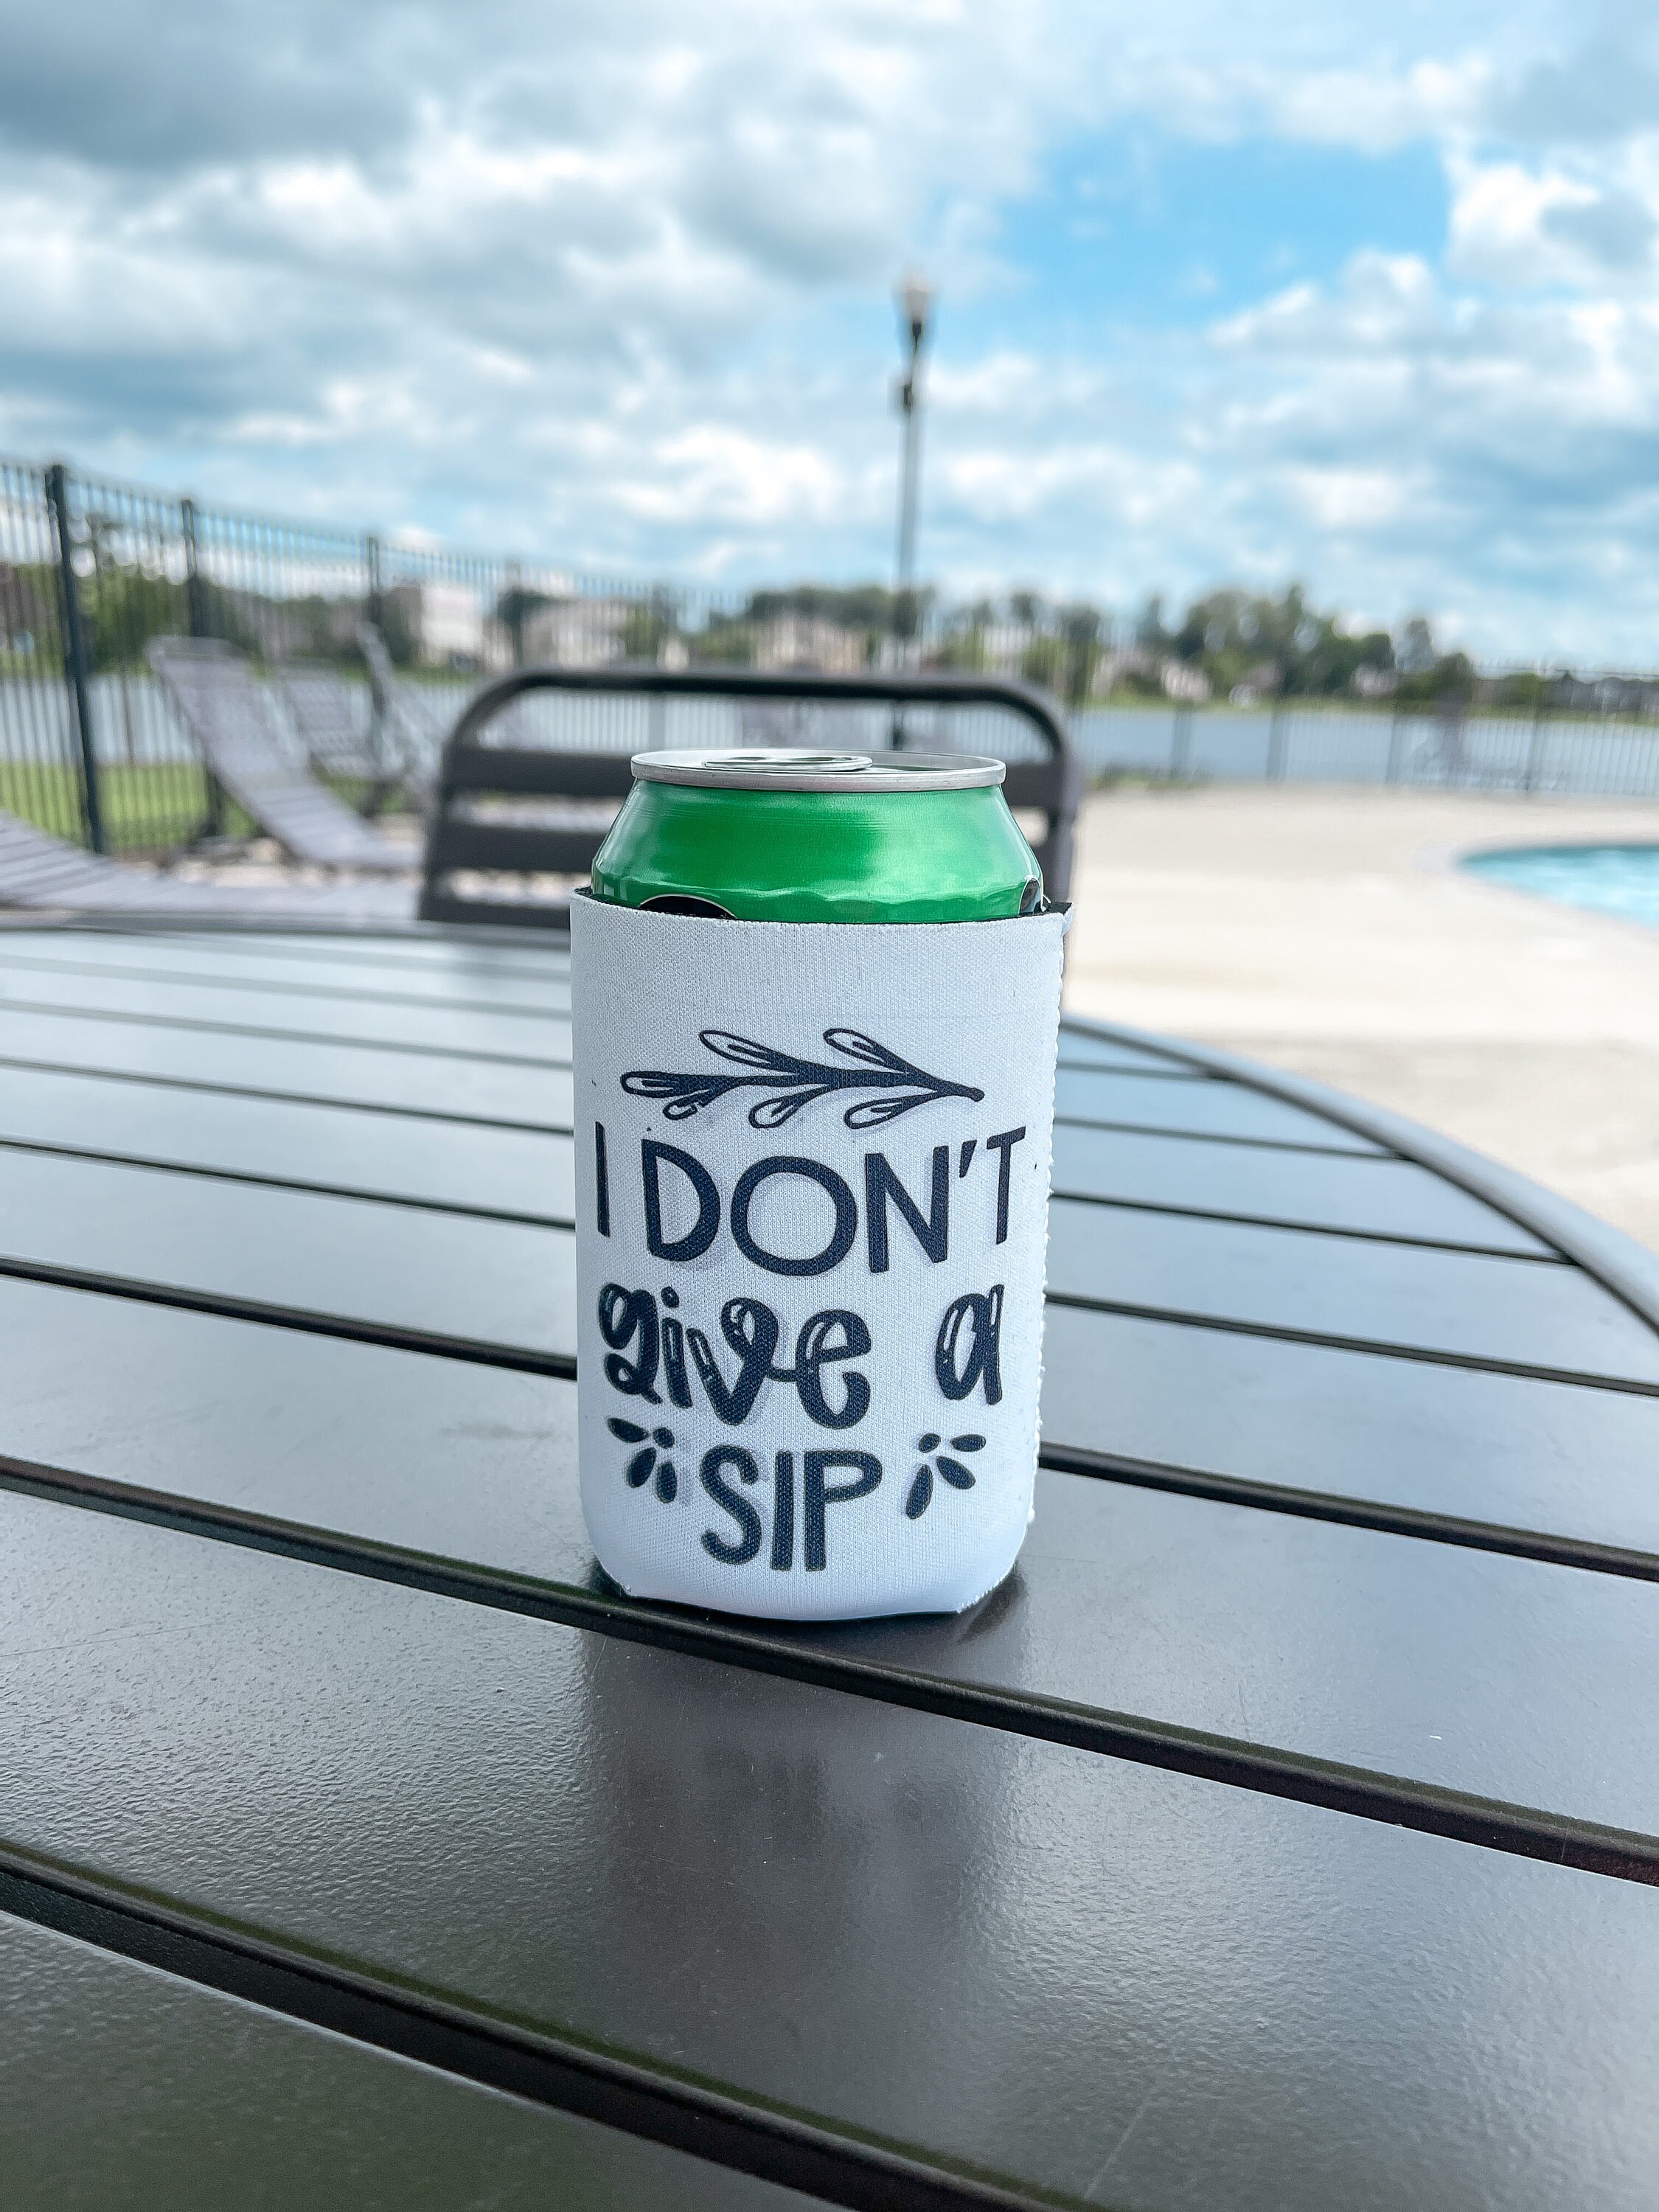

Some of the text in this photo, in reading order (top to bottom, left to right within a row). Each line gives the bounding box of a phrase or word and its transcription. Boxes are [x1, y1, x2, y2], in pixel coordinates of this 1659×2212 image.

[594, 1120, 1026, 1281] I DON'T
[596, 1281, 1005, 1431] give a
[698, 1443, 884, 1573] SIP
